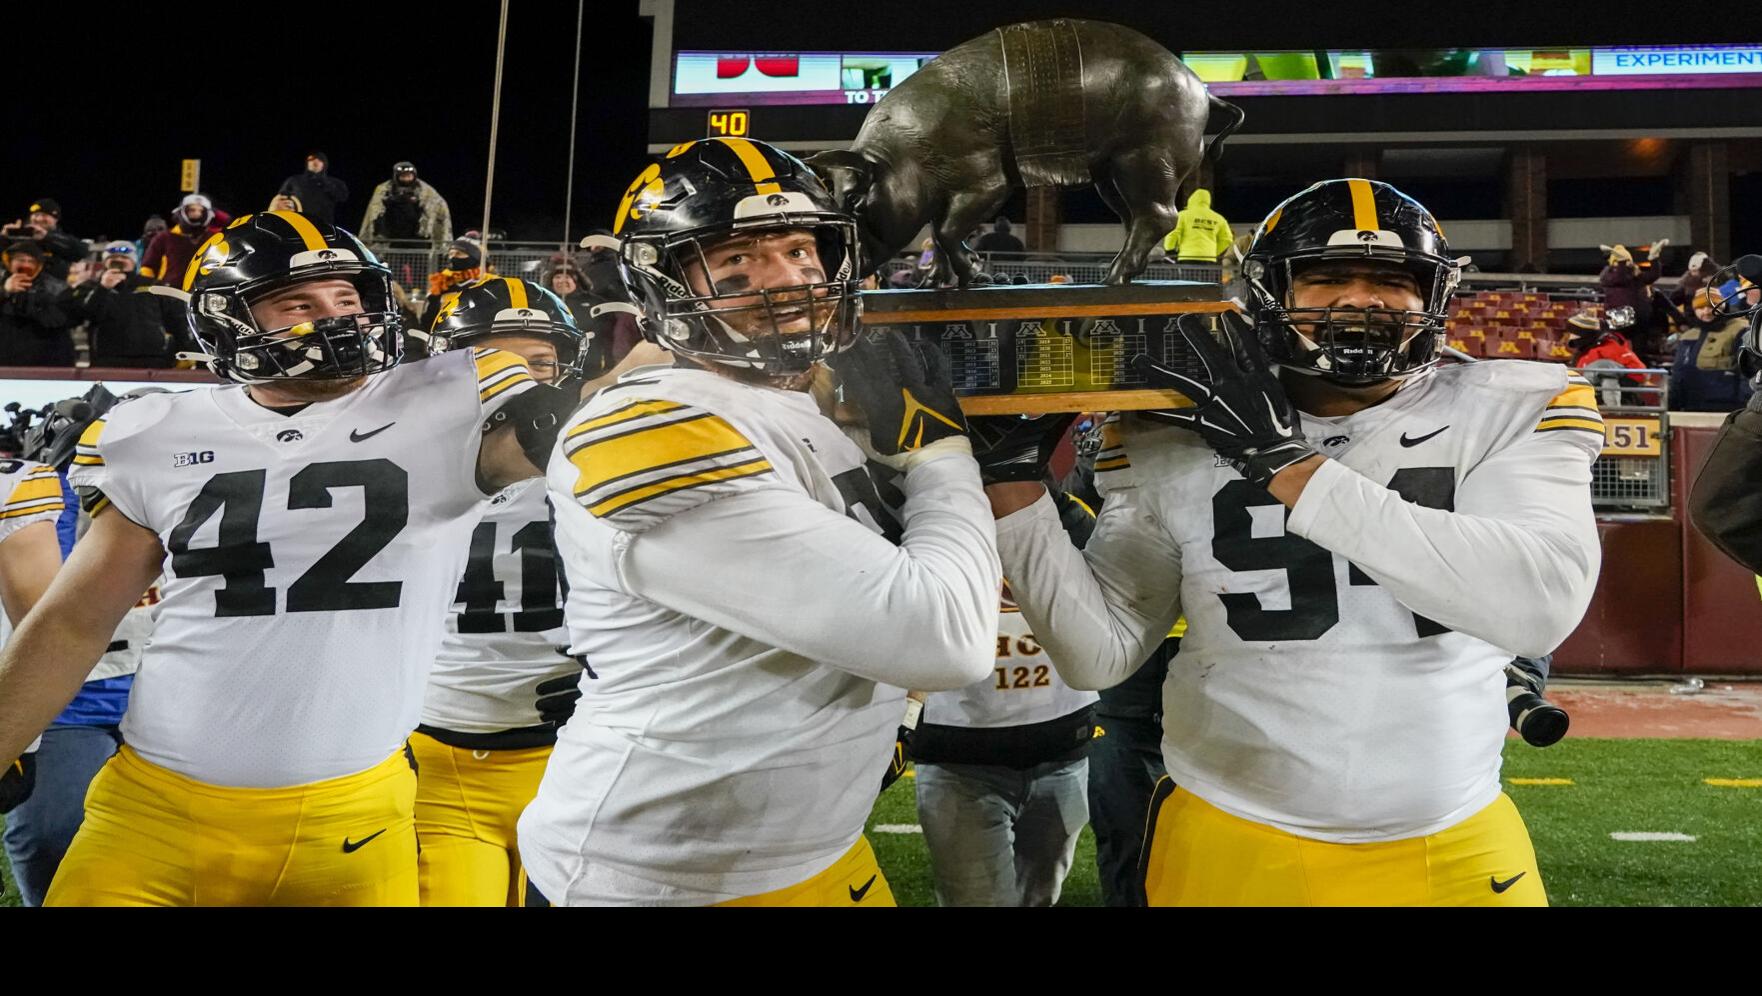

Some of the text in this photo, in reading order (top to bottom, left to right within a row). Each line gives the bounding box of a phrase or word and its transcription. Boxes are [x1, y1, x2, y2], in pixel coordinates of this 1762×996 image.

[845, 91, 869, 104] TO
[711, 112, 747, 135] 40
[170, 458, 409, 618] 42
[995, 664, 1051, 690] 122
